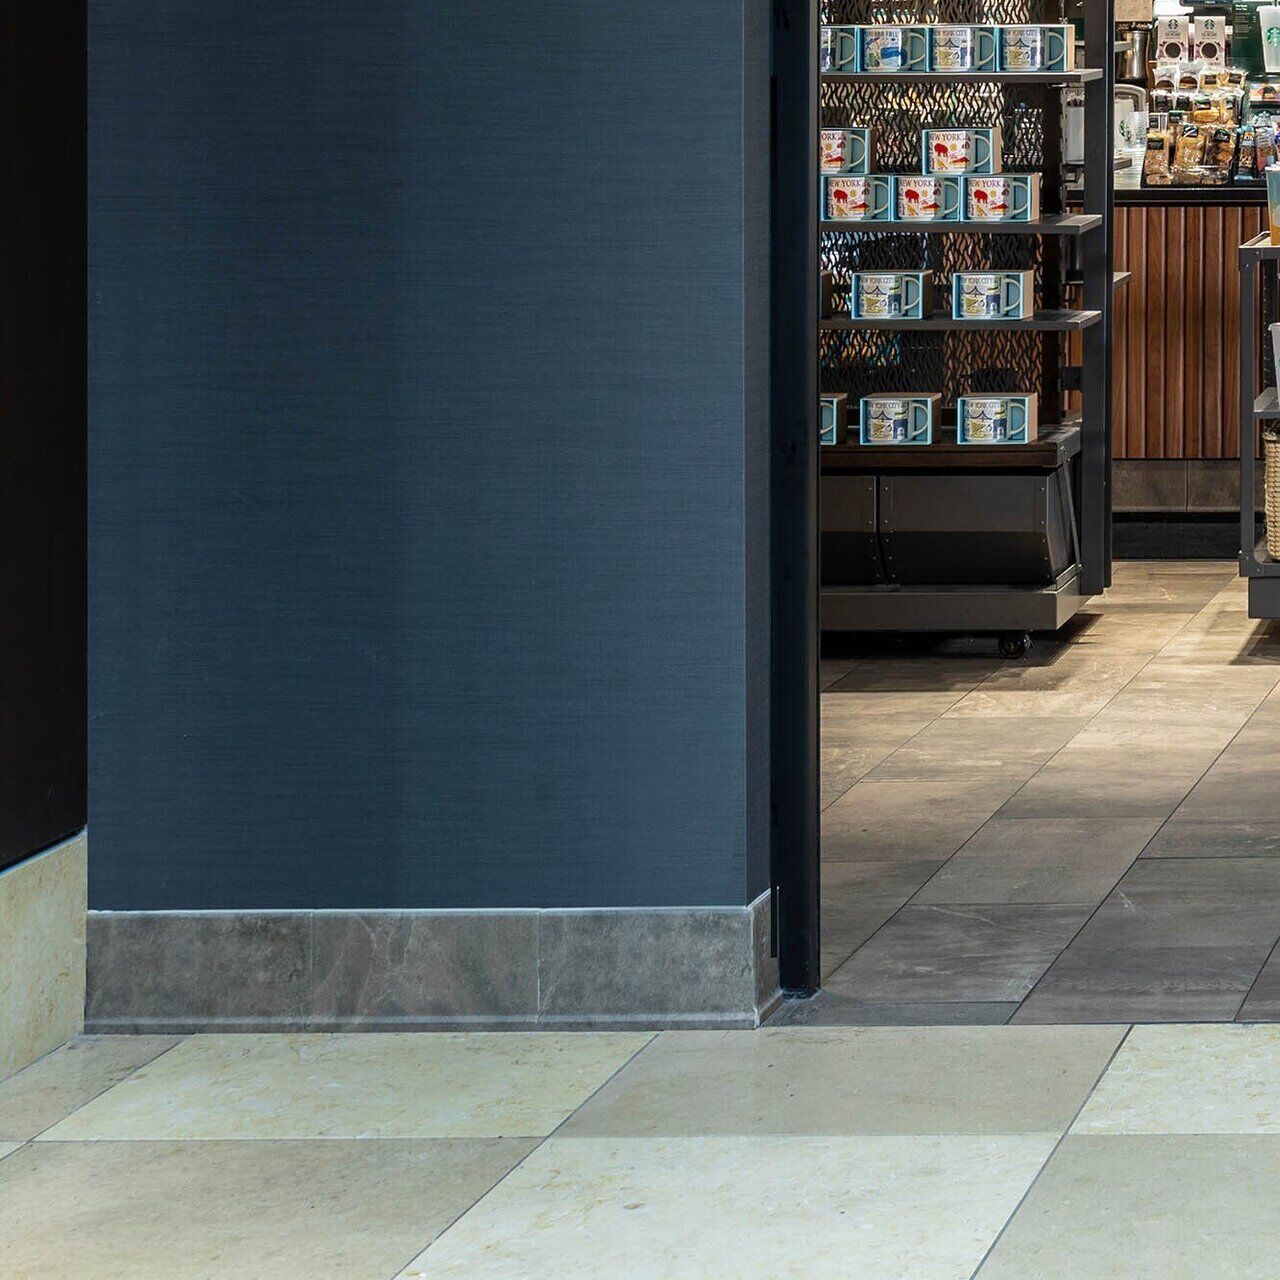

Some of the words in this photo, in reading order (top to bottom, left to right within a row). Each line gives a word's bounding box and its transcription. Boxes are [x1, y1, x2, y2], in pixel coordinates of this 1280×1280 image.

[822, 133, 837, 141] ORK
[941, 133, 962, 141] YORK
[841, 179, 863, 187] YORK
[912, 179, 933, 187] YORK
[980, 179, 1002, 187] YORK
